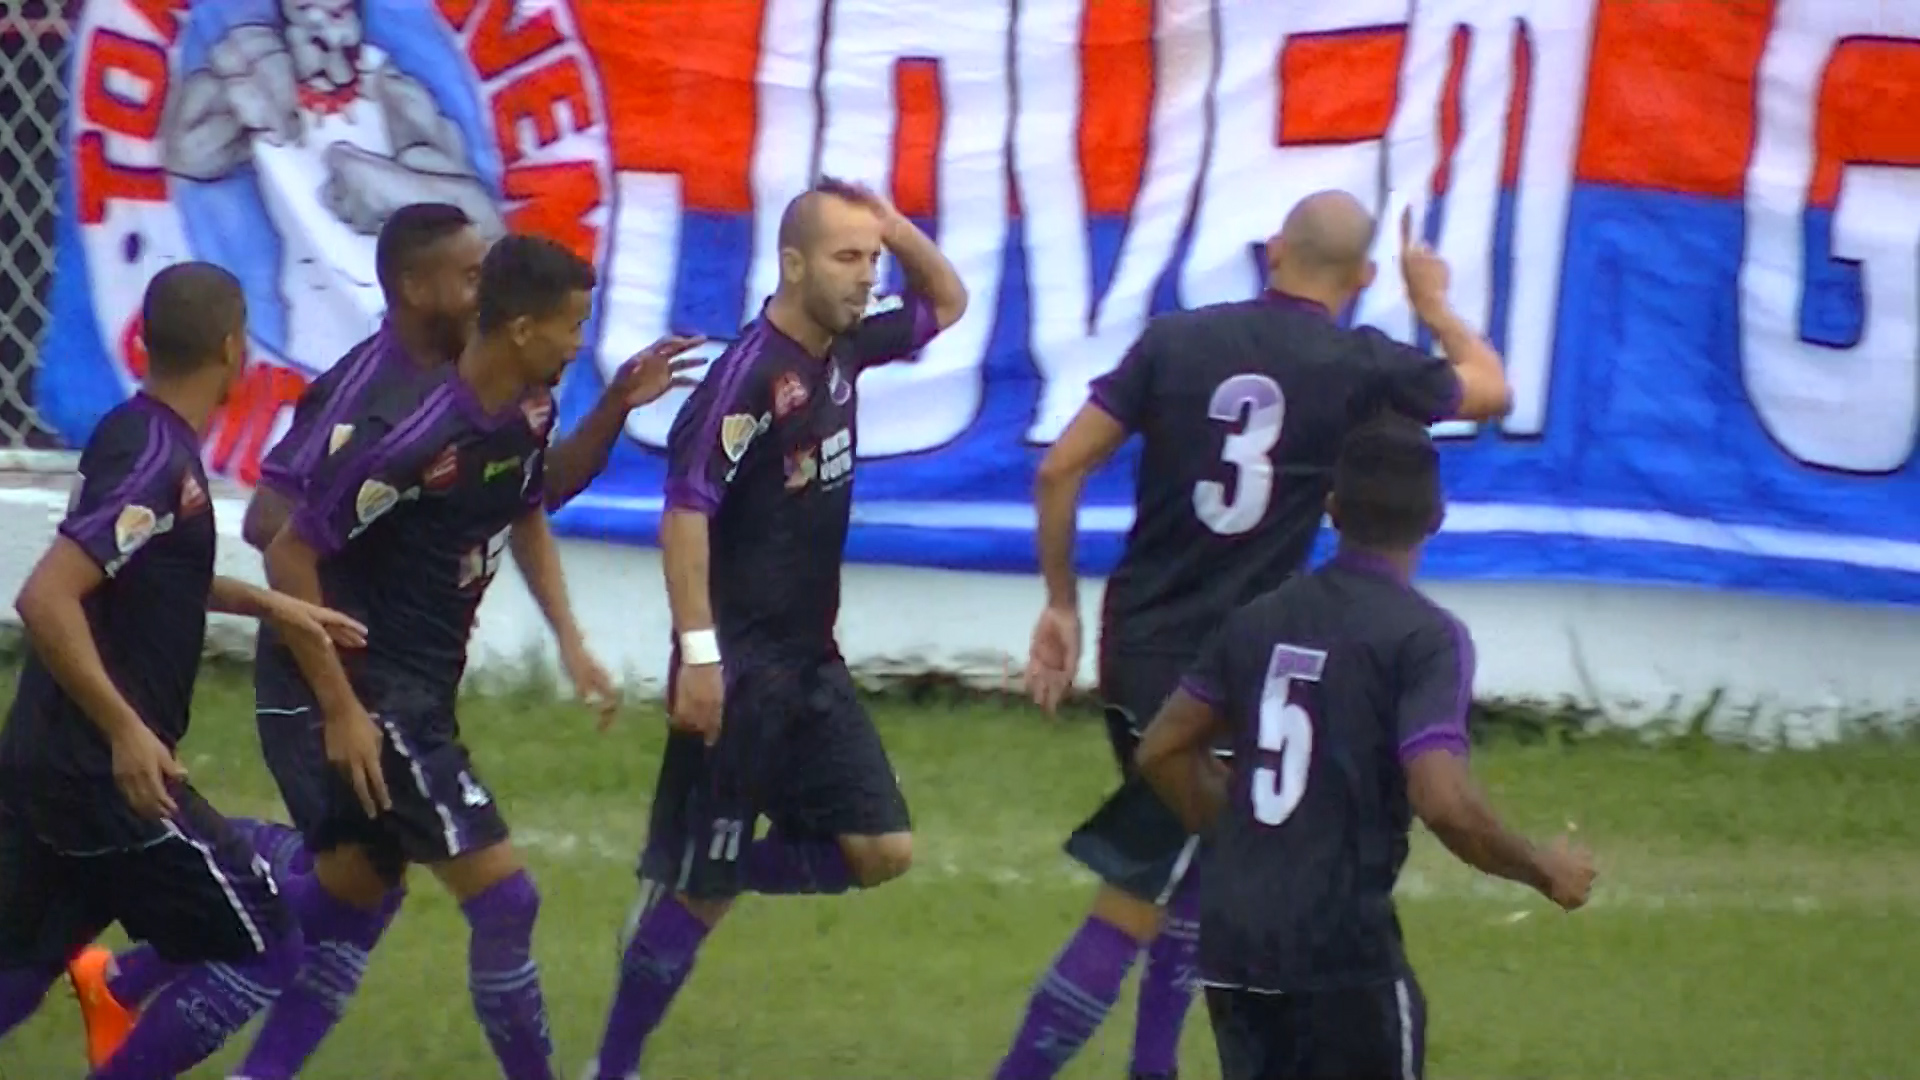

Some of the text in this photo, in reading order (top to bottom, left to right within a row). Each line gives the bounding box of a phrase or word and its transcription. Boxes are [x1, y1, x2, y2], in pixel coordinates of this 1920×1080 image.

[1192, 373, 1286, 536] 3
[1252, 643, 1328, 827] 5
[709, 817, 743, 862] 11
